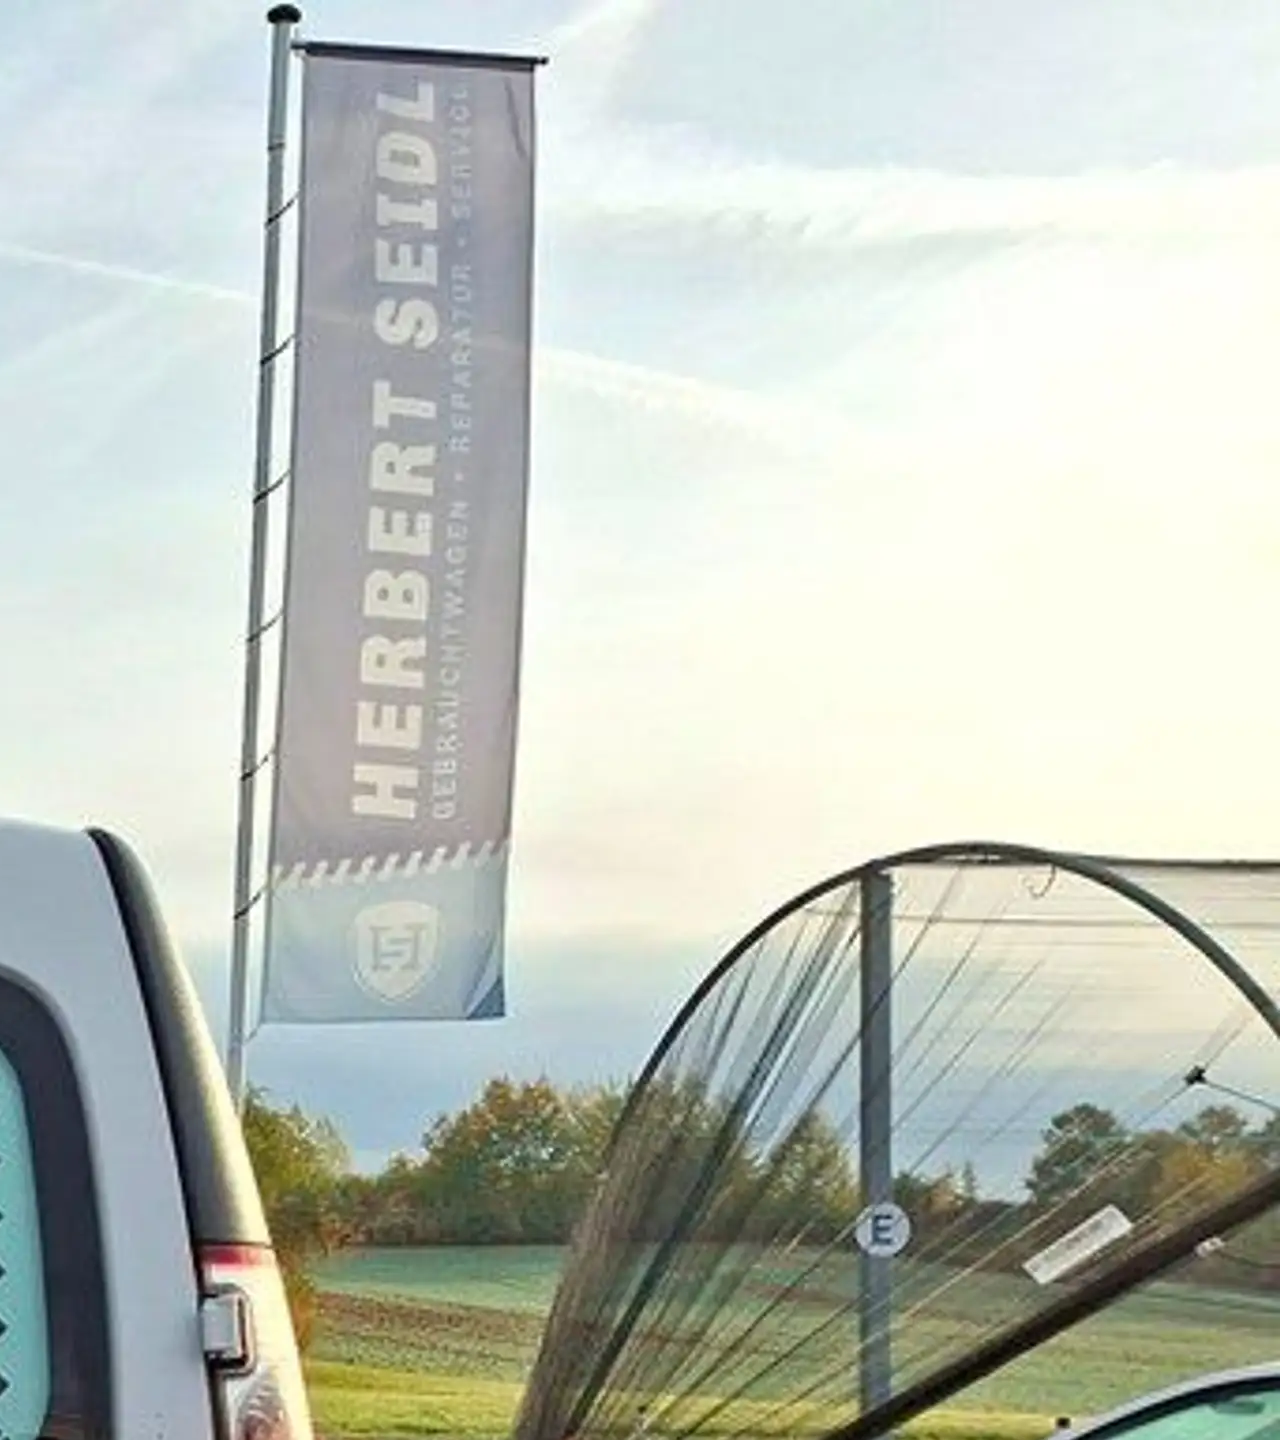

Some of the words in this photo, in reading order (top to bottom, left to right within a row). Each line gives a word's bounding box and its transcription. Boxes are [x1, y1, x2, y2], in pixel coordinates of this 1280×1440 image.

[373, 81, 438, 349] SEIDL
[449, 263, 473, 453] REPARATUR
[351, 379, 437, 821] HERBERT
[432, 500, 471, 820] GEBRAUCHTWAGEN
[871, 1214, 894, 1246] E
